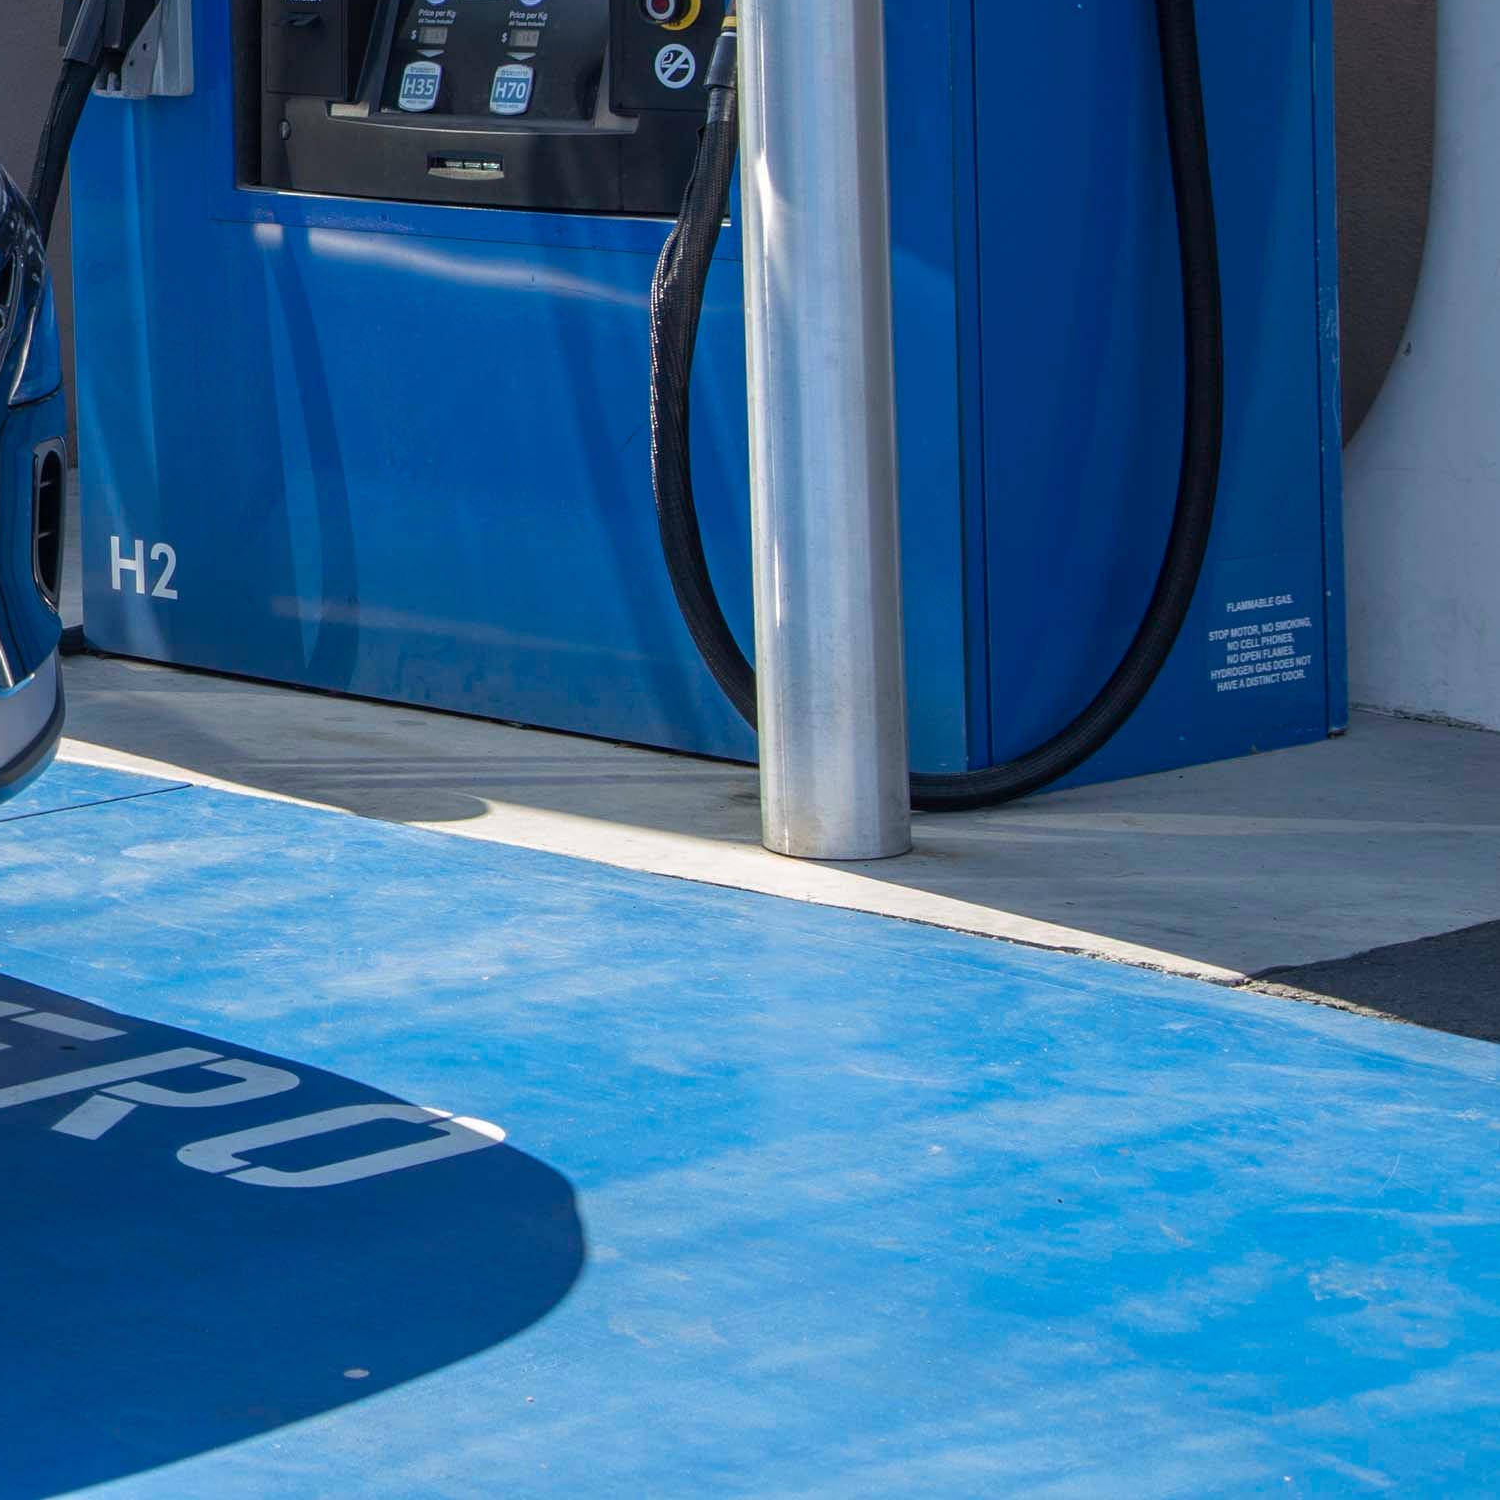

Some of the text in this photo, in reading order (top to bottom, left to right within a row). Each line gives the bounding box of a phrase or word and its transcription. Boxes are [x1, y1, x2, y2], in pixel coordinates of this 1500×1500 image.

[418, 9, 456, 19] Price per Kg
[510, 10, 548, 20] Price per Kg
[404, 78, 435, 95] H35
[495, 81, 526, 99] H70
[110, 536, 178, 600] H2
[1226, 597, 1274, 612] FLAMMABLE
[1208, 617, 1312, 642] STOP MOTOR, NO SMOKING,
[1227, 641, 1239, 651] NO
[1240, 639, 1260, 649] CELL
[1226, 654, 1239, 664] NO
[1240, 650, 1262, 662] OPEN
[1210, 655, 1312, 680] HYDROGEN GAS DOES NOT
[1217, 679, 1239, 692] HAVE
[1239, 679, 1246, 688] A
[1246, 673, 1280, 687] DISTINCT
